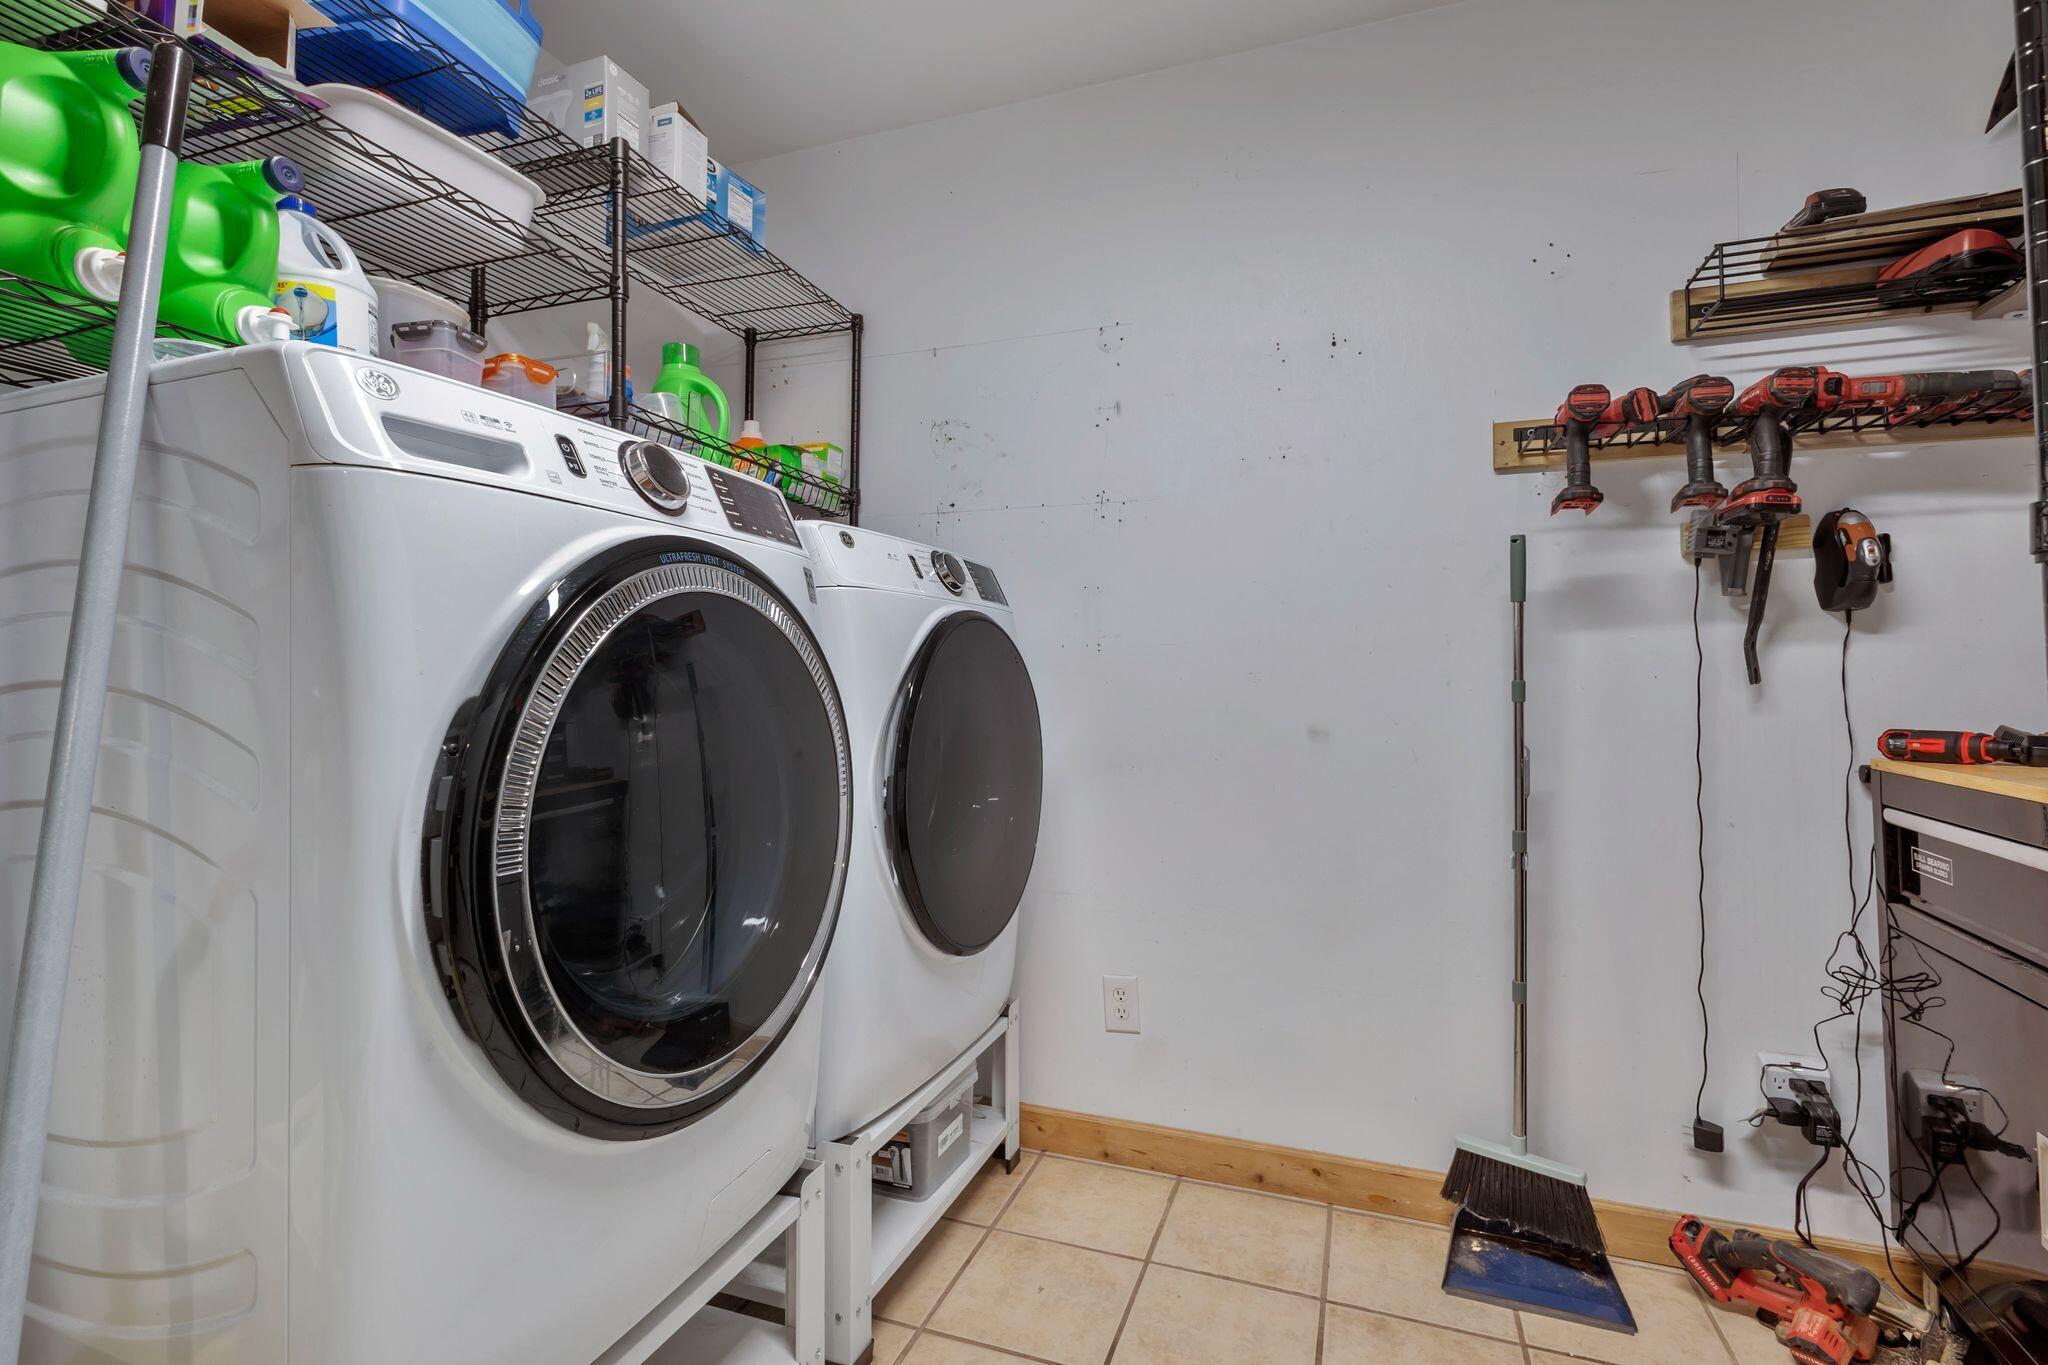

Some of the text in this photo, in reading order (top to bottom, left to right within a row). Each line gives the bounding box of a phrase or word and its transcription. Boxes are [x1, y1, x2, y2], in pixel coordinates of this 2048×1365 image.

[660, 551, 745, 575] ULTRAFRESH VENT SYSTEM
[1687, 1255, 1719, 1291] CRAFTSMAN
